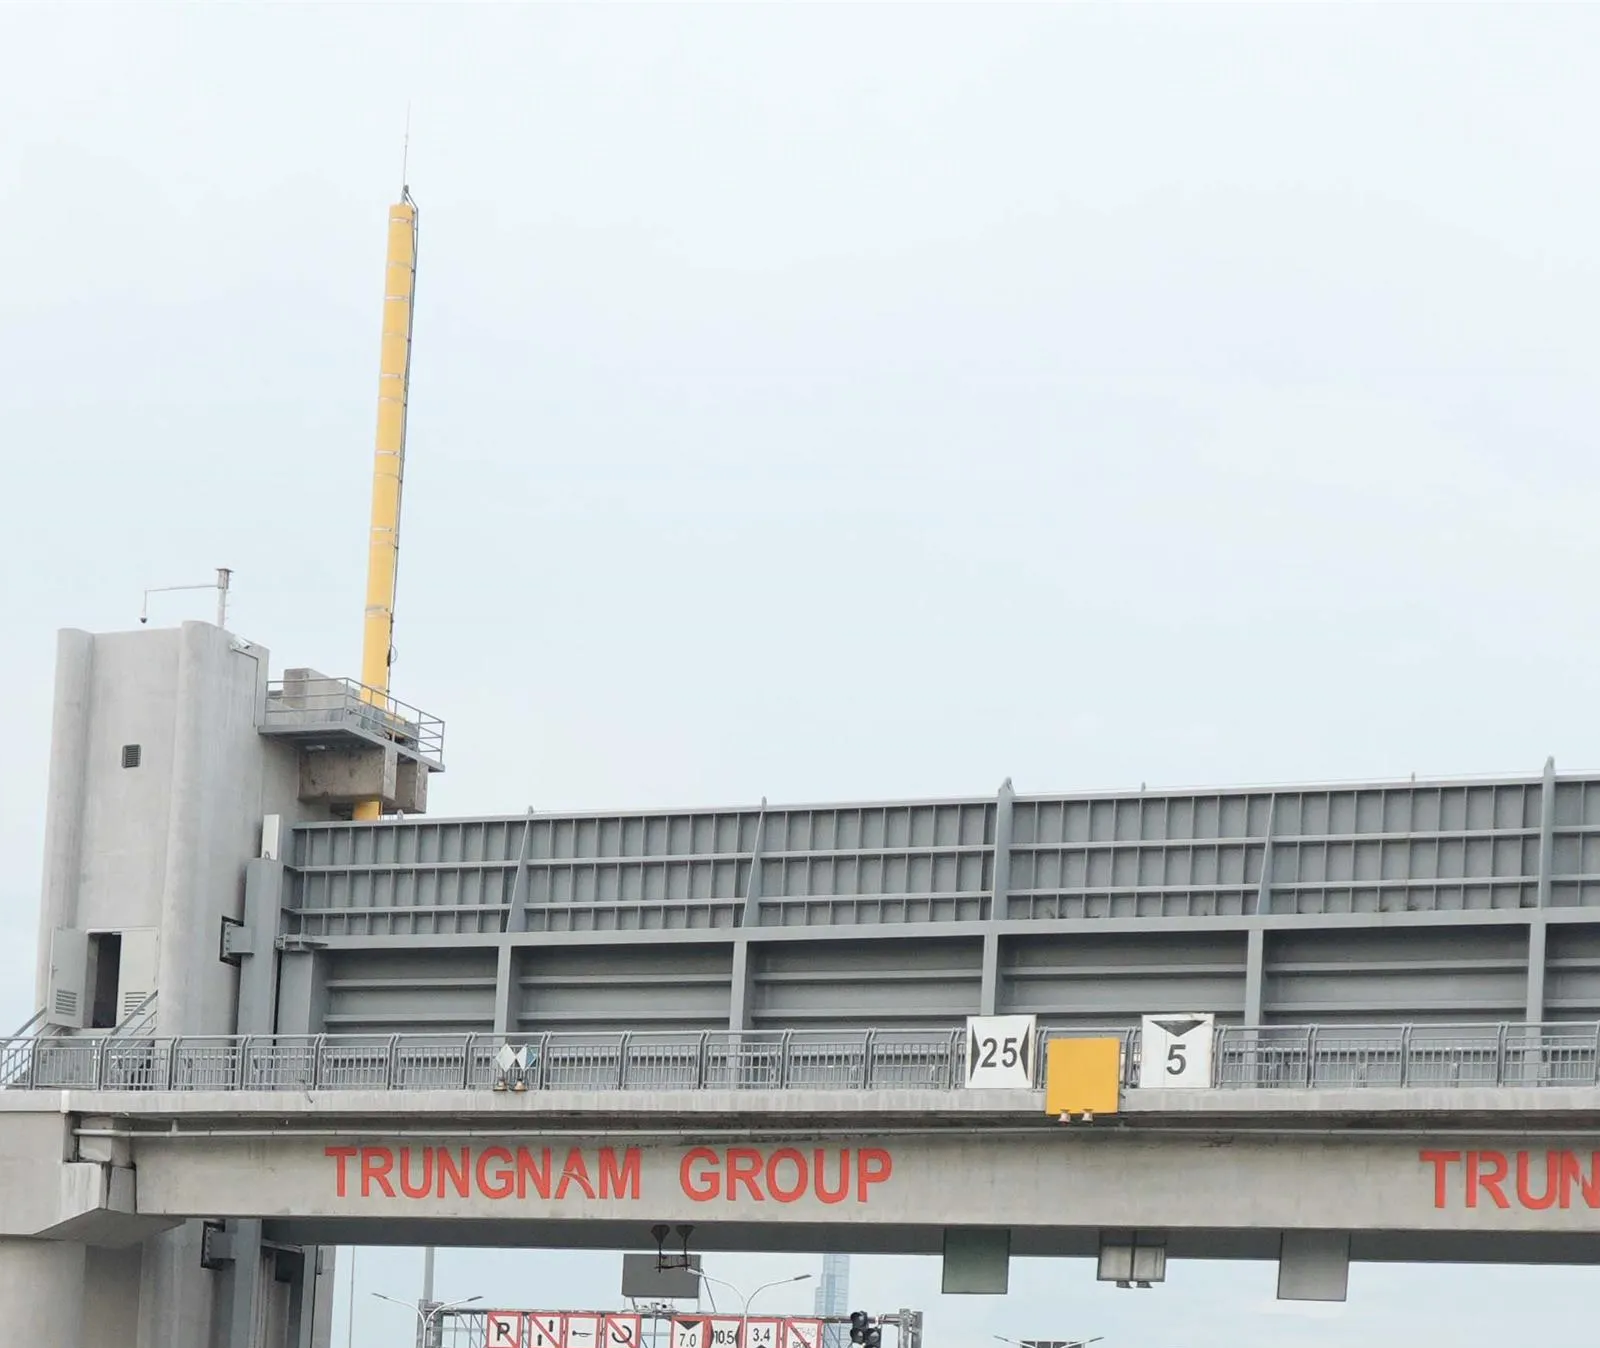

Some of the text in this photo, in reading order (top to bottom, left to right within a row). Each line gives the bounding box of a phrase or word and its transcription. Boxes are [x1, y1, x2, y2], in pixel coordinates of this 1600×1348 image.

[981, 1037, 1017, 1068] 25
[1166, 1044, 1186, 1075] 5
[325, 1145, 892, 1204] TRUNGNAM GROUP
[679, 1333, 696, 1347] 7.0
[753, 1328, 770, 1342] 3.4
